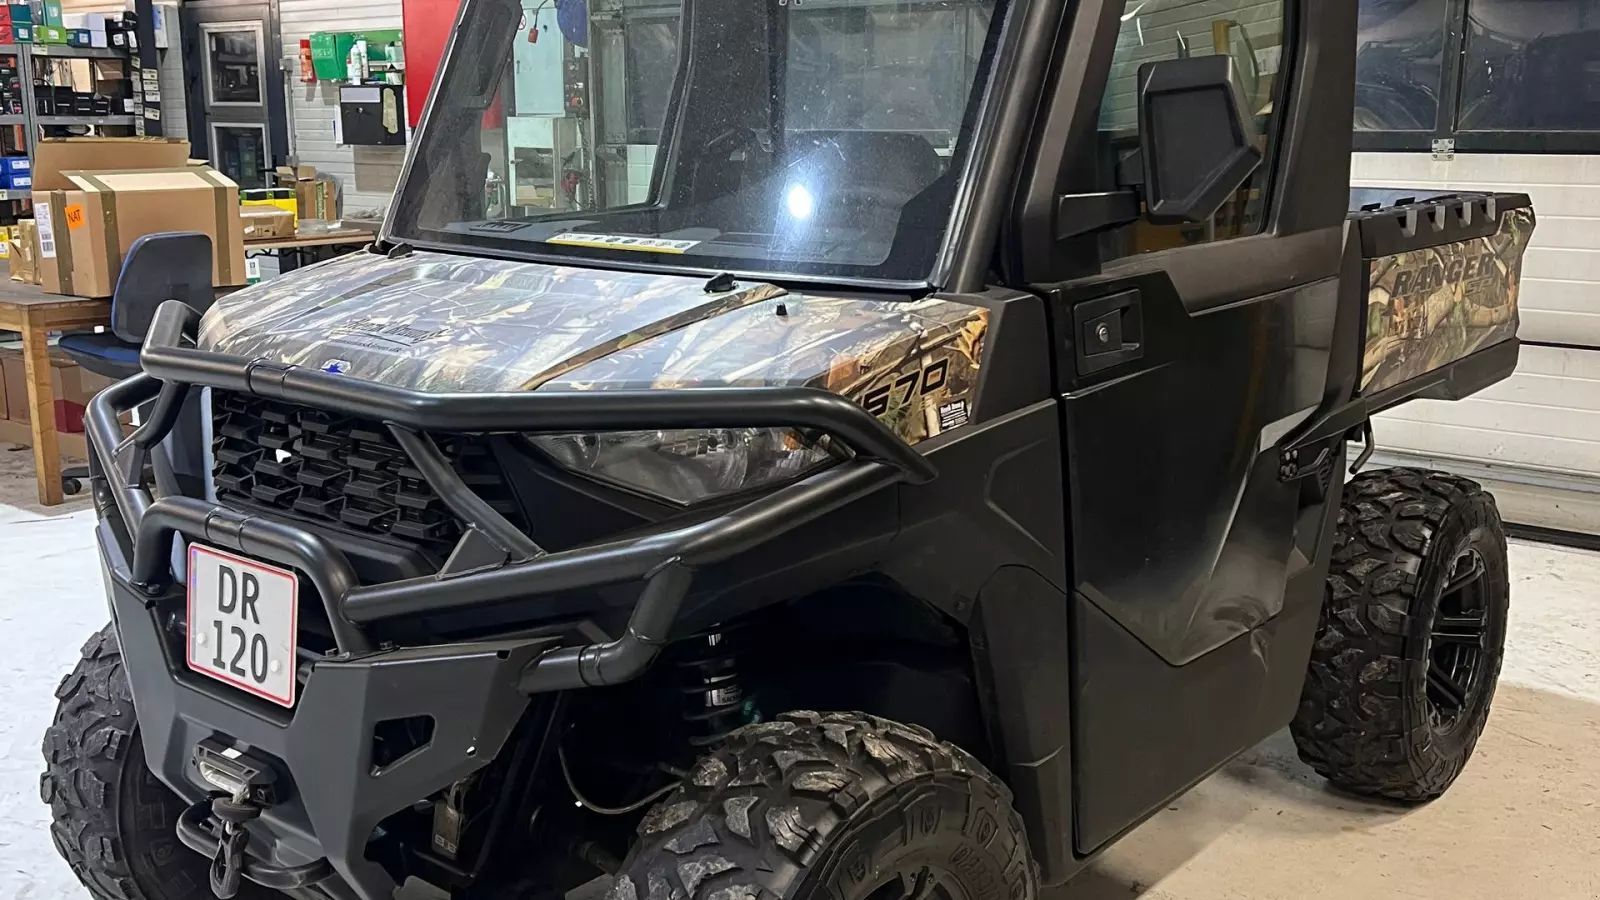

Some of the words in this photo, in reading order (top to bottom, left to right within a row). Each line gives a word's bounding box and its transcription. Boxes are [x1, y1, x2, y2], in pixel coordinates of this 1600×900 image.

[67, 209, 81, 223] NAT
[1391, 252, 1496, 298] RANGER
[1465, 278, 1492, 295] SP
[861, 356, 949, 418] 570
[217, 564, 260, 625] DR
[212, 620, 268, 684] 120
